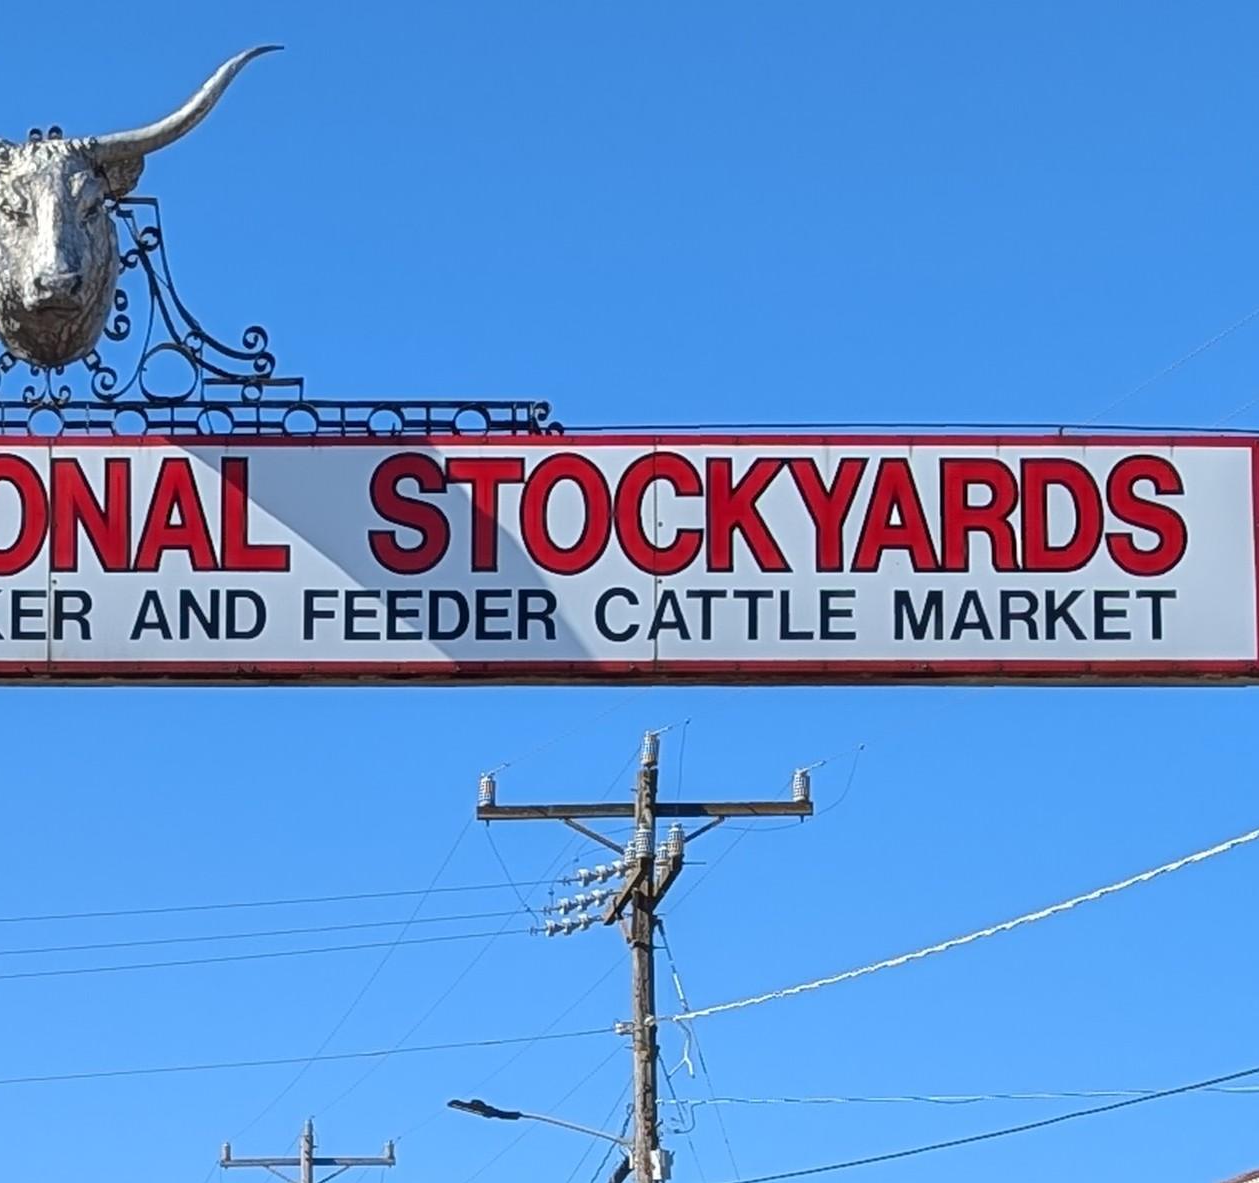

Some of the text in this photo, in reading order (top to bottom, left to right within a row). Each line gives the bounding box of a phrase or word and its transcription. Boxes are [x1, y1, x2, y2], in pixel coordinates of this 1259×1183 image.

[368, 452, 1188, 576] STOCKYARDS
[131, 590, 267, 640] AND
[304, 590, 557, 641] FEEDER
[595, 588, 856, 641] CATTLE
[894, 590, 1177, 640] MARKET
